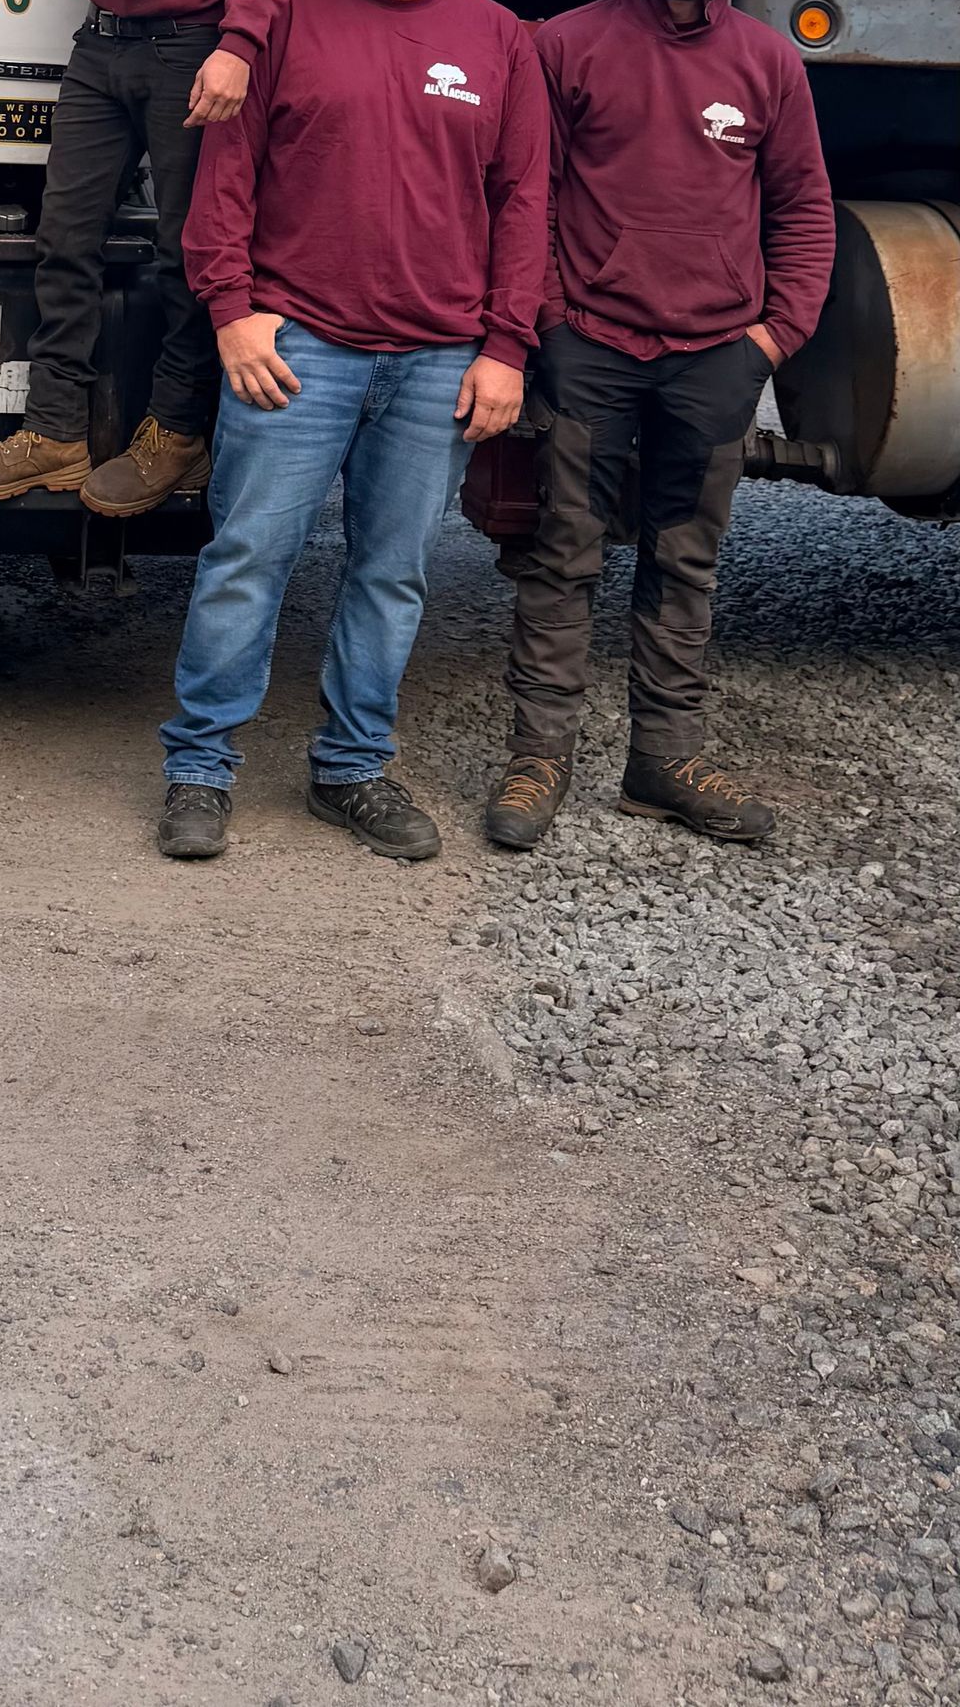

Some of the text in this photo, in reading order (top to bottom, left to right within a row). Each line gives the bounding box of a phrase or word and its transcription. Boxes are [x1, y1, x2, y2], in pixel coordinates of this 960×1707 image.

[423, 83, 481, 106] ALL ACCESS
[6, 103, 25, 112] WE
[720, 134, 746, 144] ACCESS
